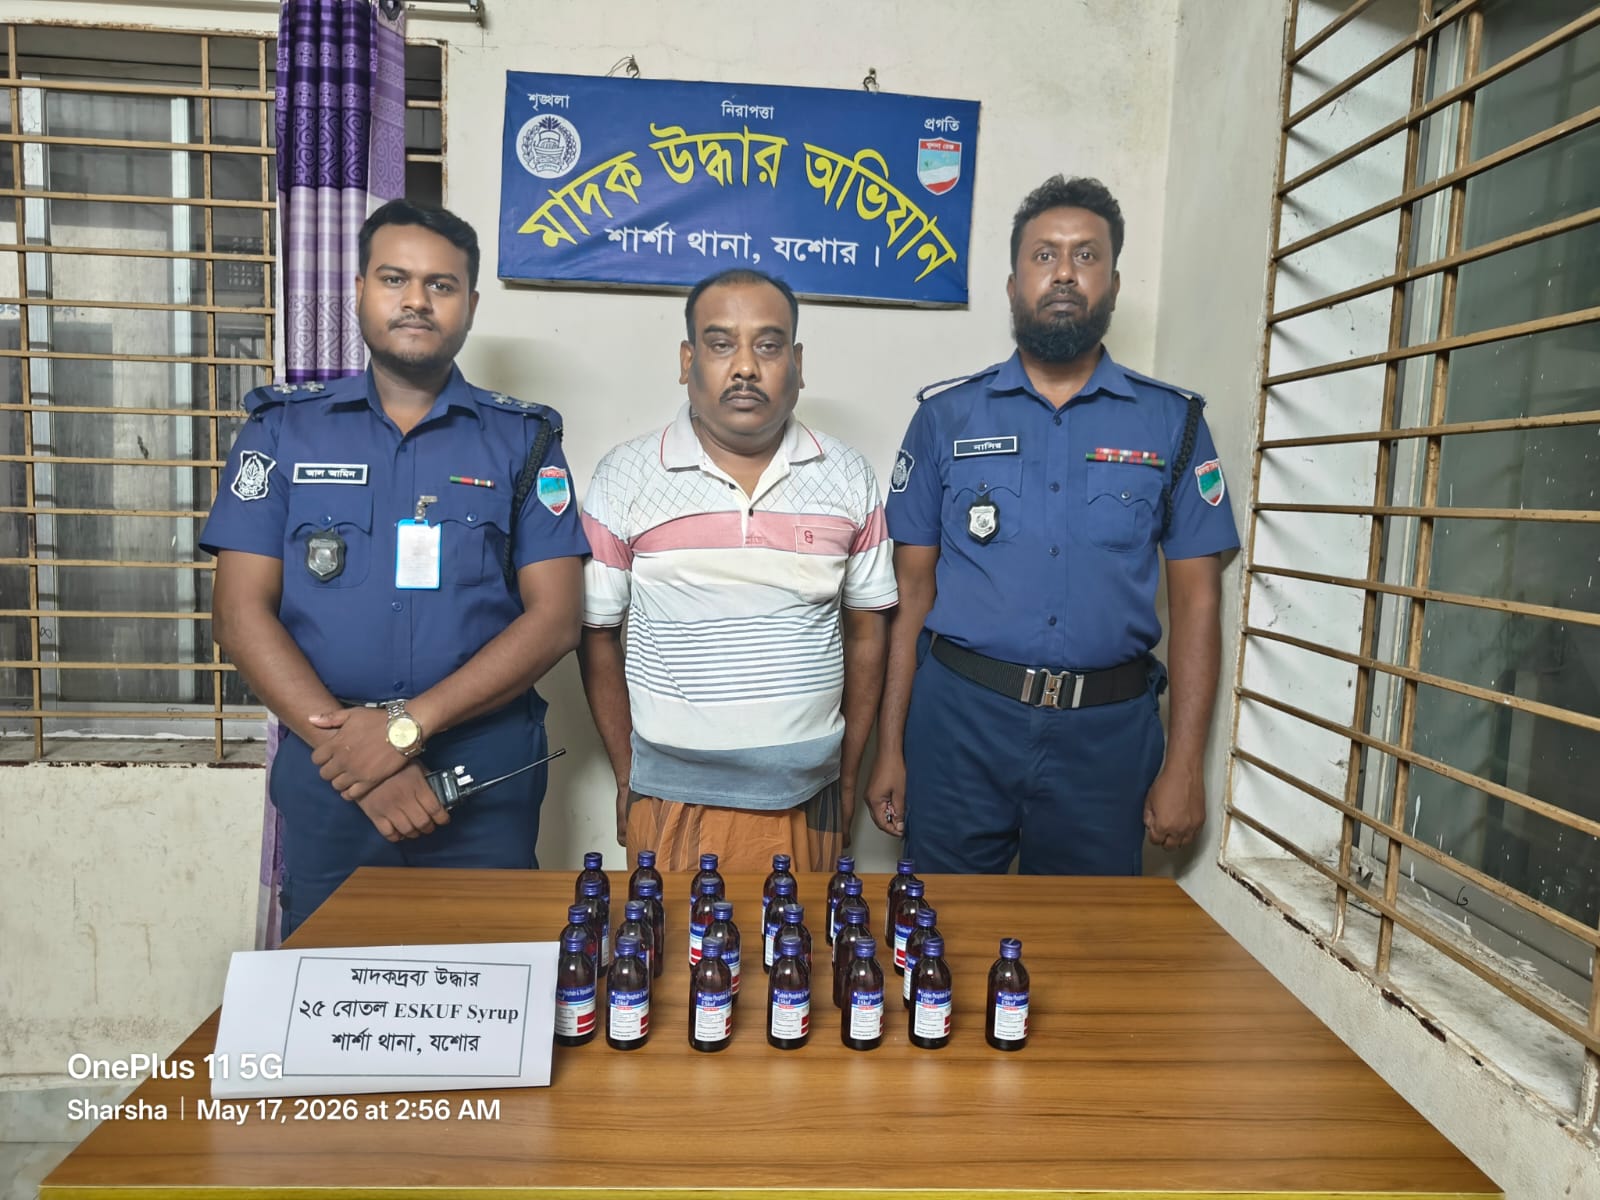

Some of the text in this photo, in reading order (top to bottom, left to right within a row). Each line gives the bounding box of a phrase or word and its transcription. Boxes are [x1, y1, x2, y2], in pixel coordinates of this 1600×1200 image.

[720, 100, 775, 120] নিরাপত্তা
[924, 116, 960, 132] প্রগতি
[517, 122, 957, 283] মাদক উদ্ধার অভিযান
[604, 222, 677, 255] শার্শা
[687, 229, 760, 264] থানা,
[771, 236, 859, 266] যশোর
[350, 965, 481, 987] মাদকদ্রব্য উদ্ধার
[299, 999, 519, 1024] ২৫ বোতল ESKUF Syrup
[331, 1027, 481, 1055] শার্শা থানা, যশোর
